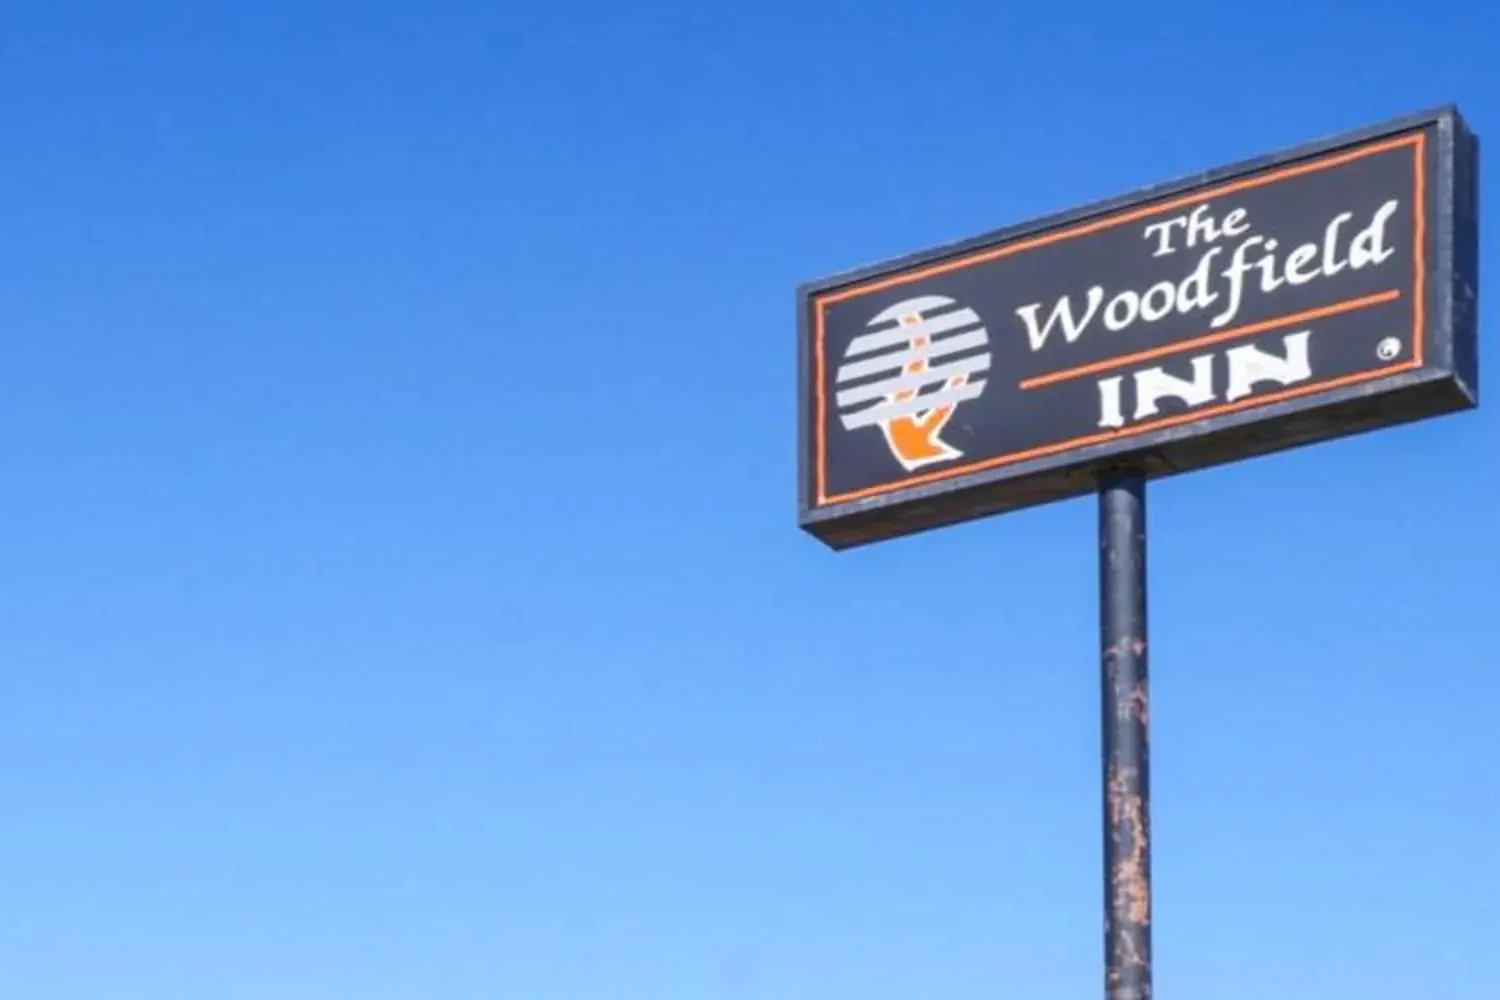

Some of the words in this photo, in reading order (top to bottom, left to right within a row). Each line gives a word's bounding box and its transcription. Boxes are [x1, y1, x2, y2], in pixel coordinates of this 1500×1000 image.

[1016, 199, 1398, 351] Woodfield
[1144, 204, 1250, 257] The
[1097, 331, 1312, 427] INN
